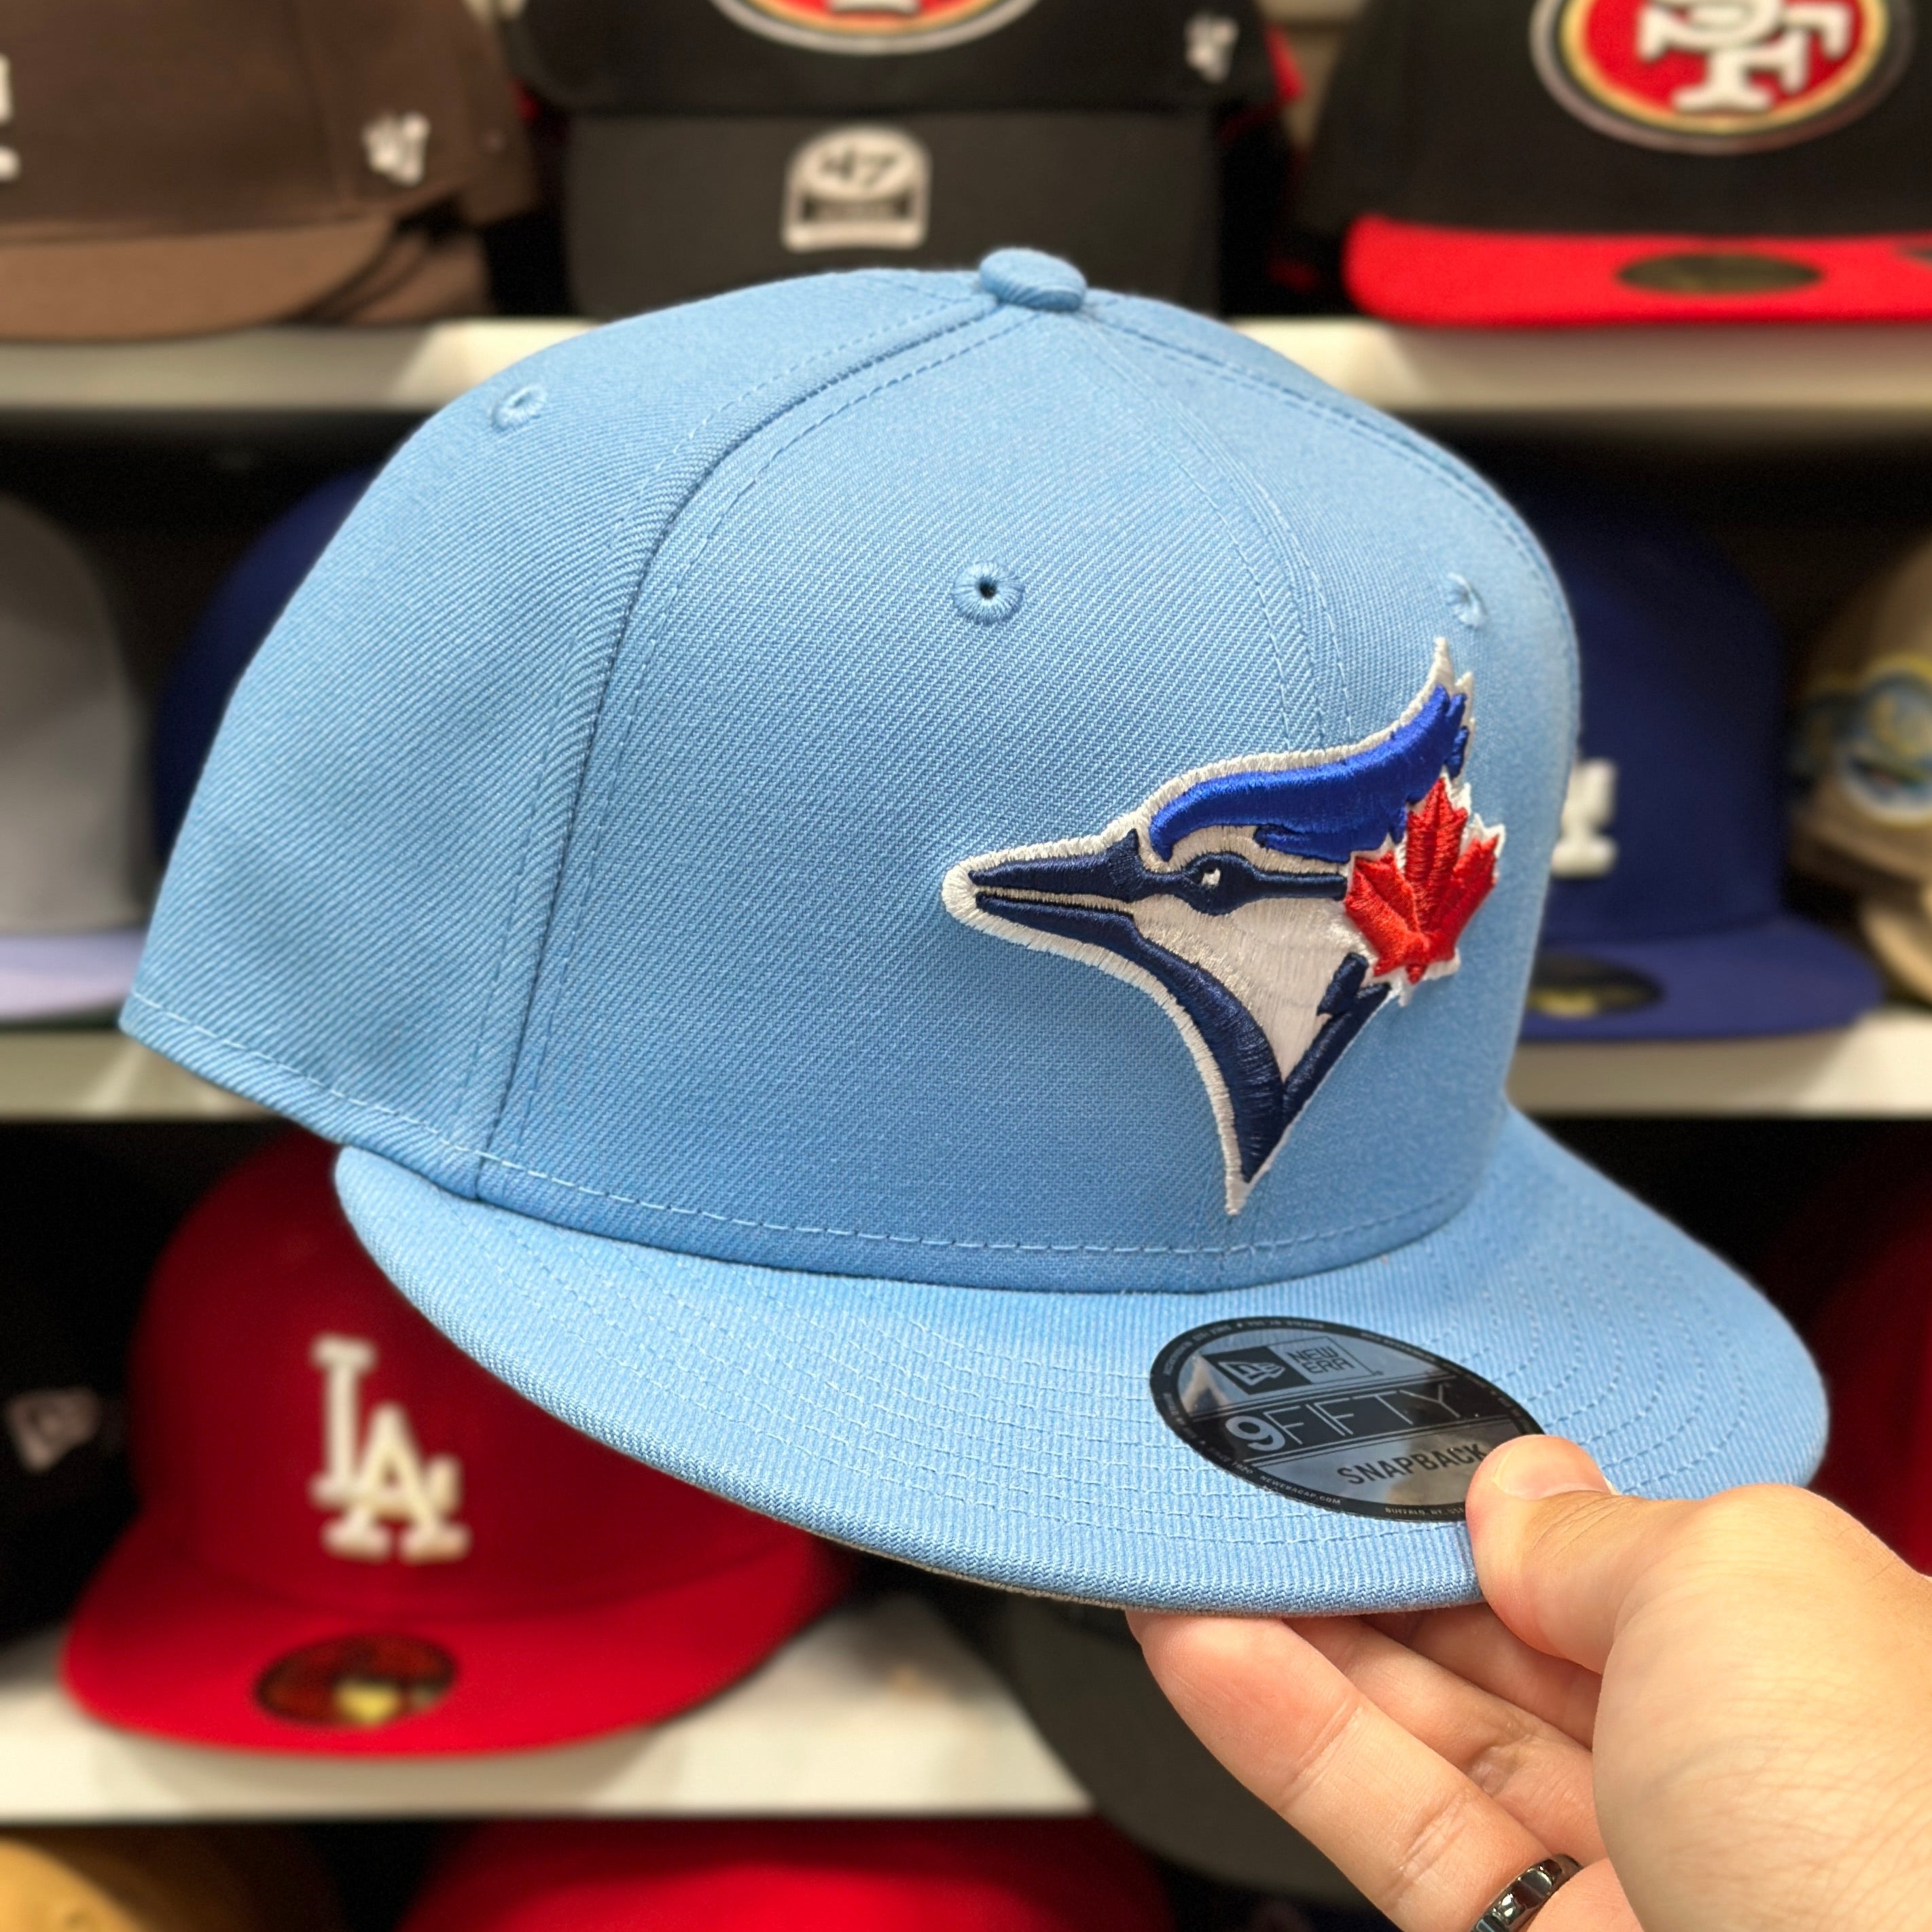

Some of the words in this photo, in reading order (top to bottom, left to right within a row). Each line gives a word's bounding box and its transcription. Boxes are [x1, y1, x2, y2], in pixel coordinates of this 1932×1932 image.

[1286, 1346, 1340, 1363] NEW
[1301, 1358, 1356, 1374] ERA
[1225, 1383, 1461, 1452] 9FIFTY
[309, 1331, 472, 1562] LA
[1336, 1443, 1486, 1485] SNAPBACK
